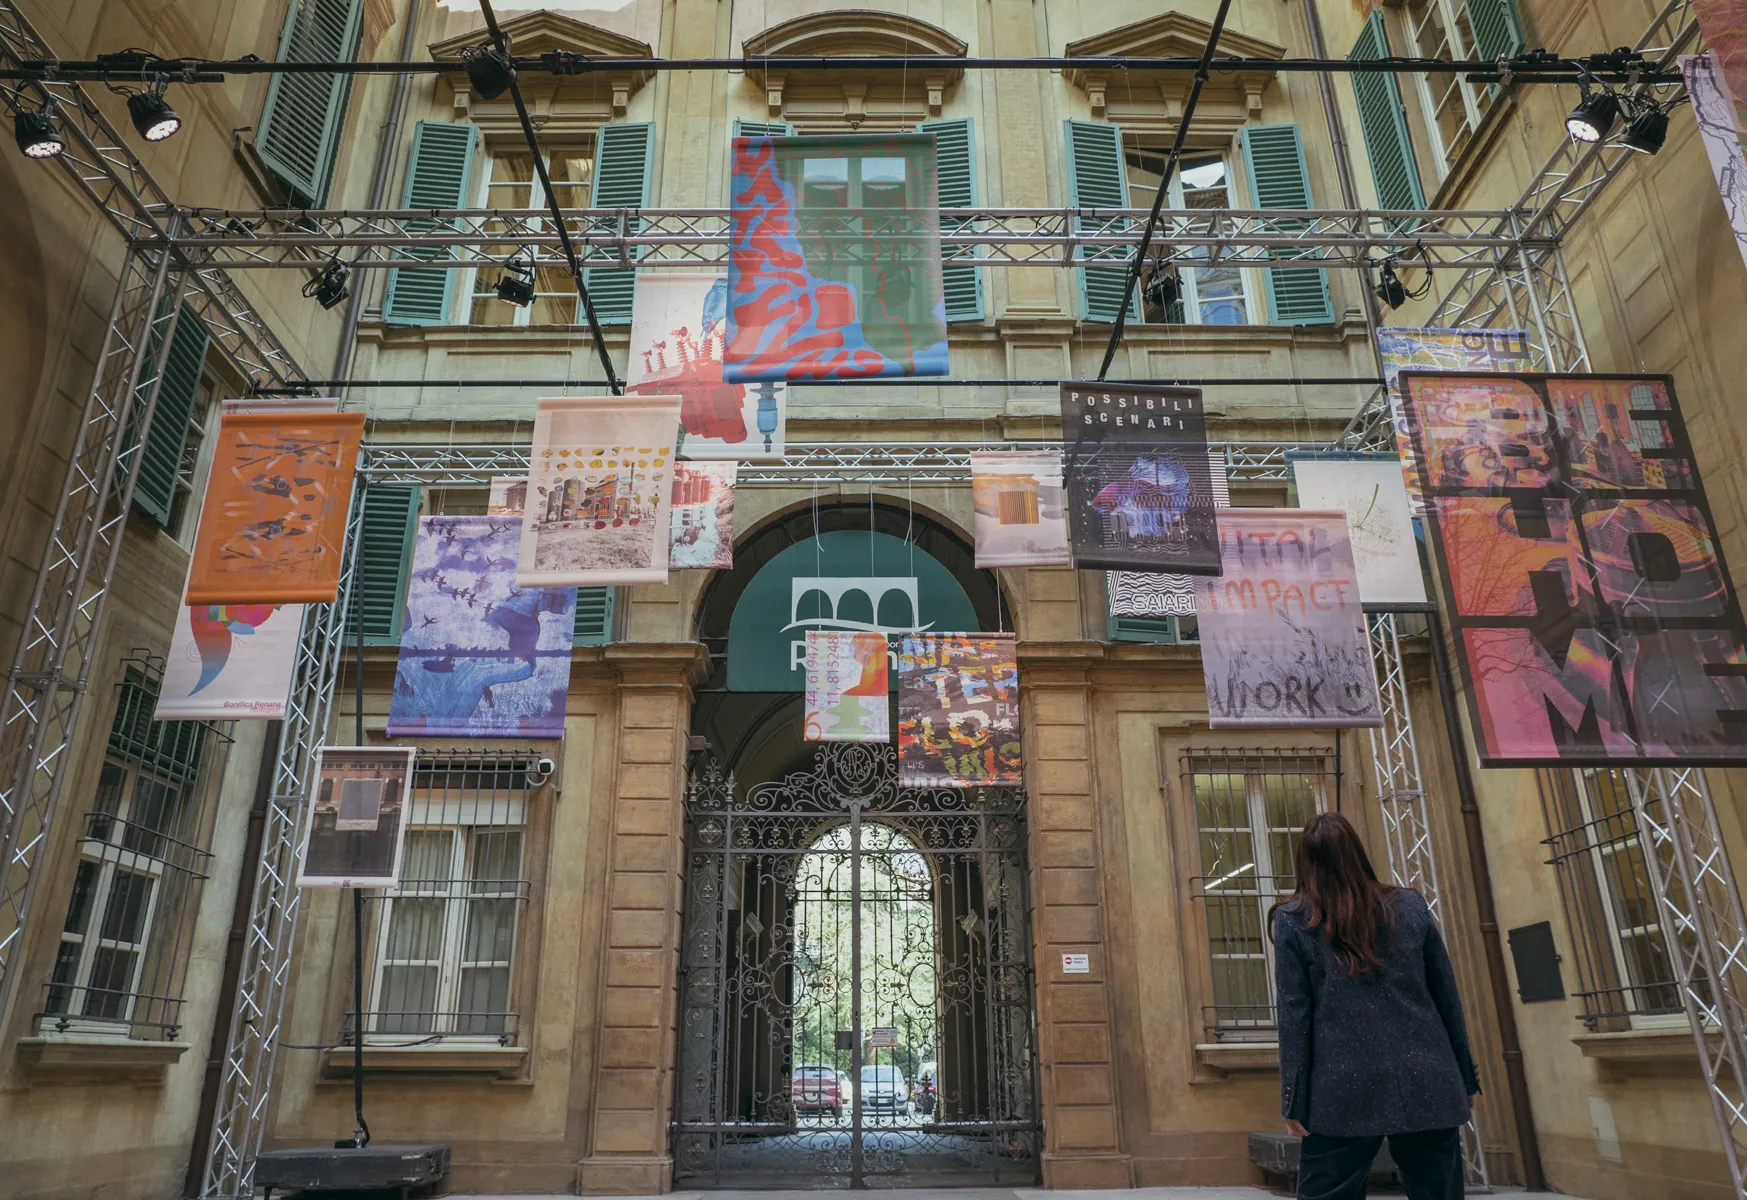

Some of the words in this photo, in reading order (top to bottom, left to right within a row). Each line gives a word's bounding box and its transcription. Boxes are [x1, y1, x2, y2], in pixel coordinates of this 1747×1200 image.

[1071, 392, 1193, 411] POSSIBILI
[1084, 412, 1184, 430] SCENARI
[1206, 578, 1352, 616] IMPACT
[1212, 674, 1328, 719] WORK
